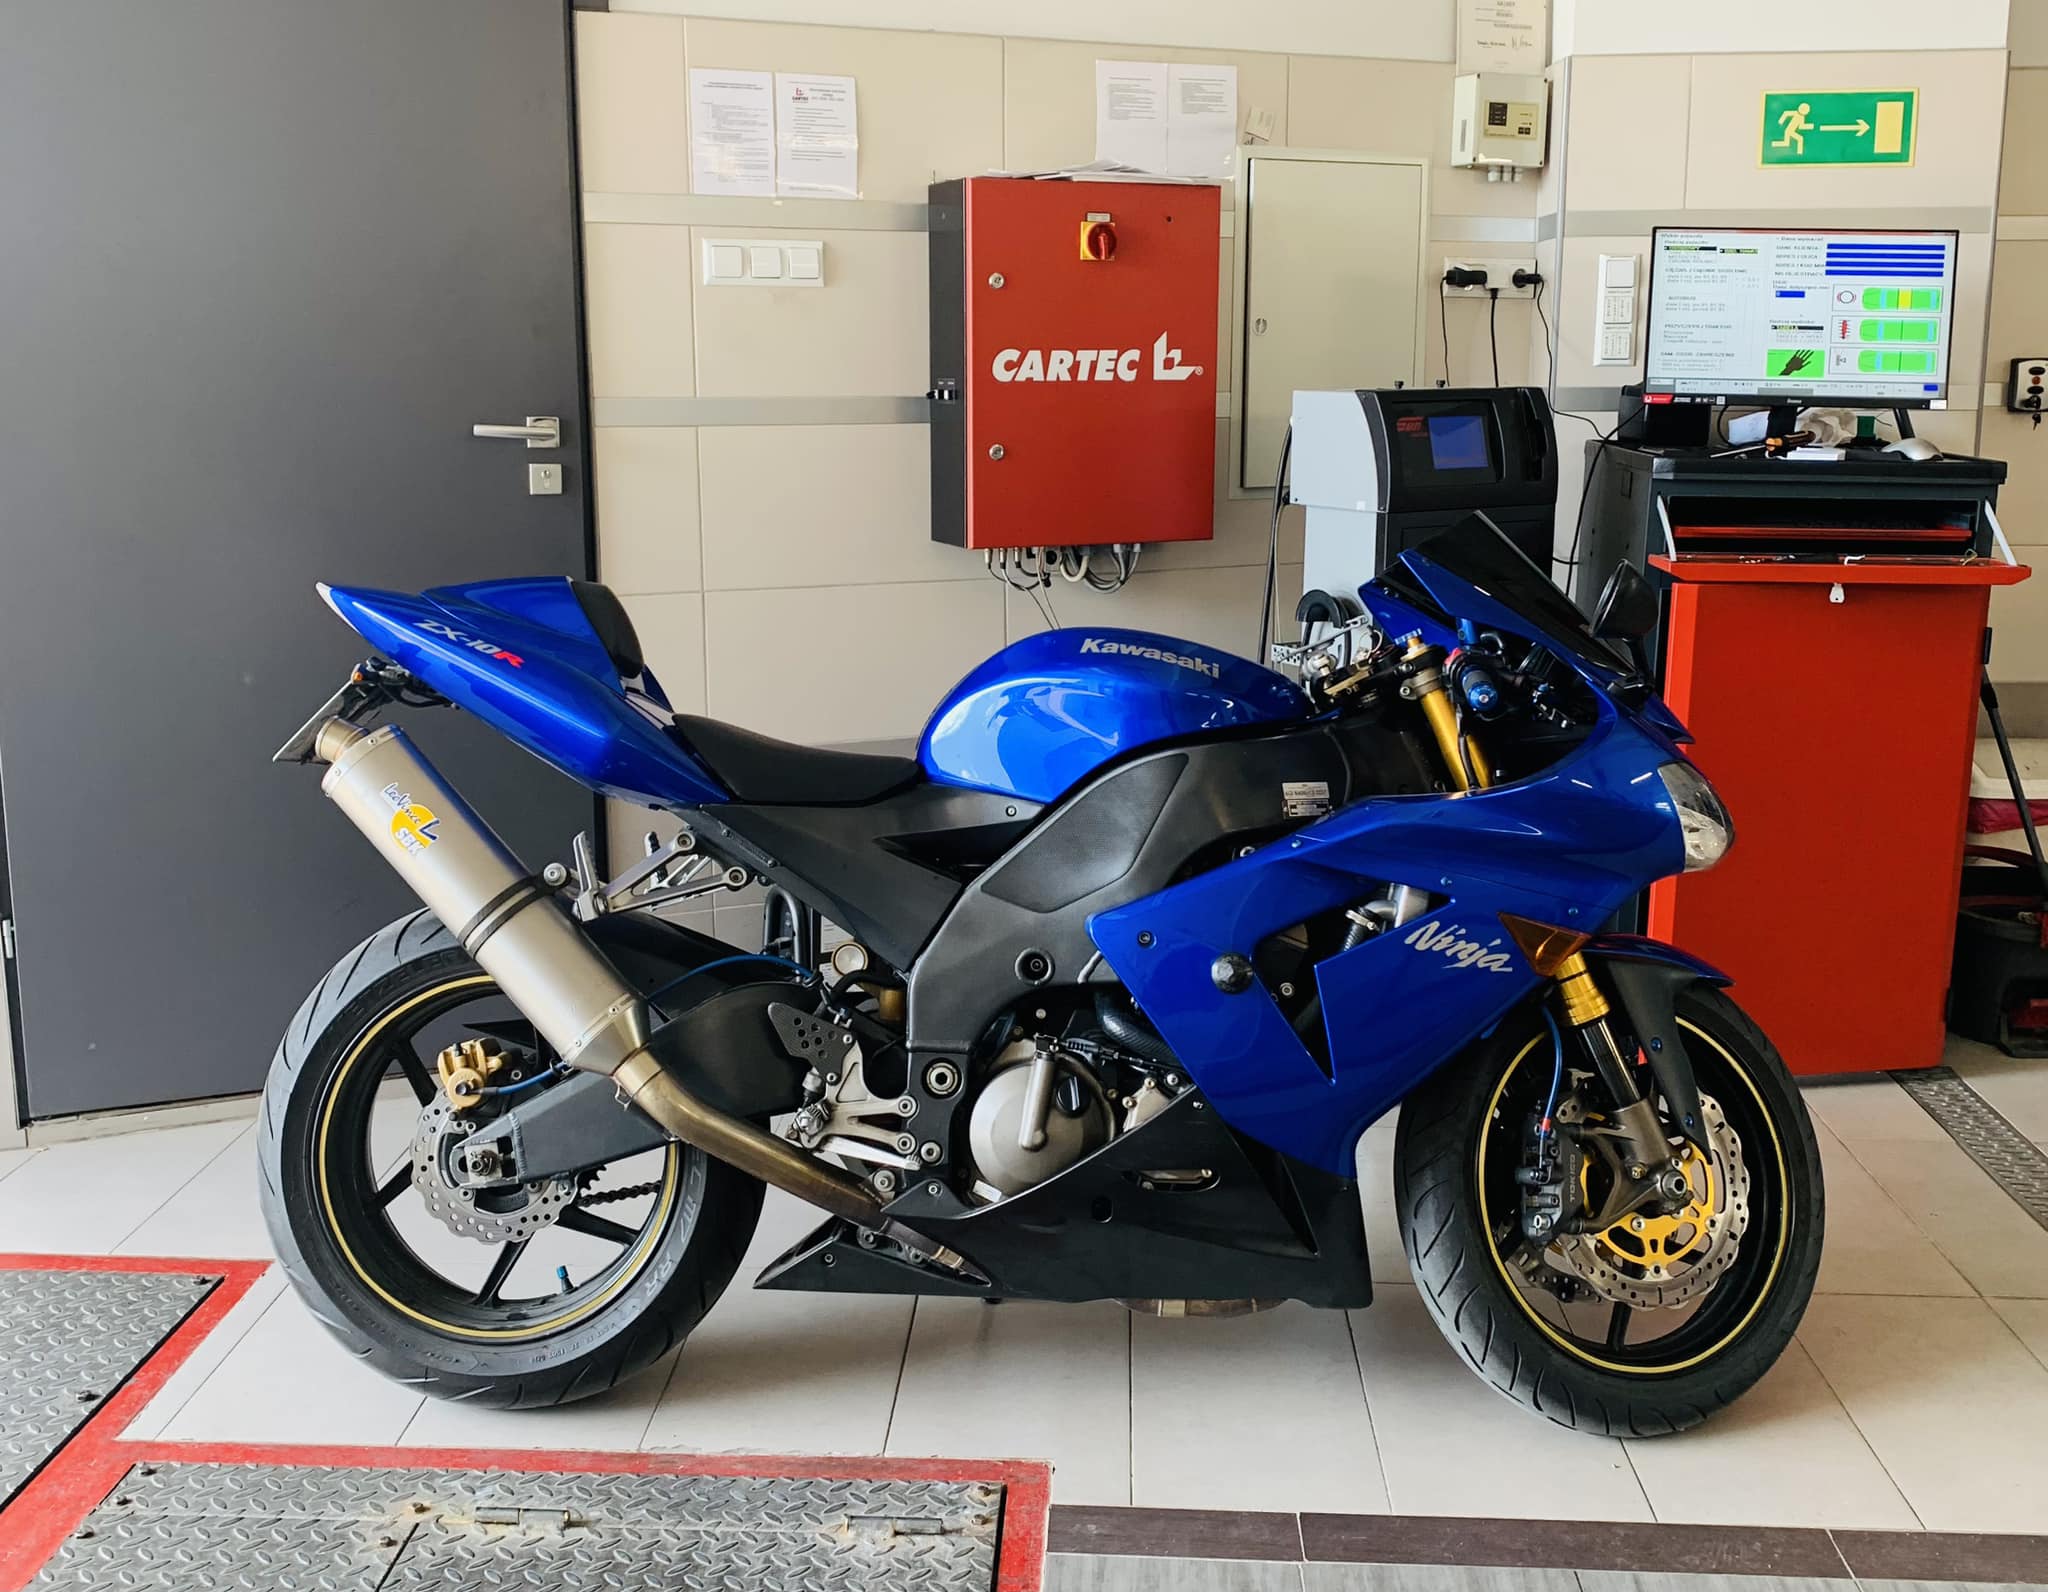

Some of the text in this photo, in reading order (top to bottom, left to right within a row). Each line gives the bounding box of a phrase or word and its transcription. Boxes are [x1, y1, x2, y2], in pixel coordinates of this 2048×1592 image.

[992, 348, 1141, 382] CARTEC
[413, 619, 525, 668] ZX-10R
[1080, 638, 1220, 679] Kawasaki
[1404, 920, 1513, 972] Ninja
